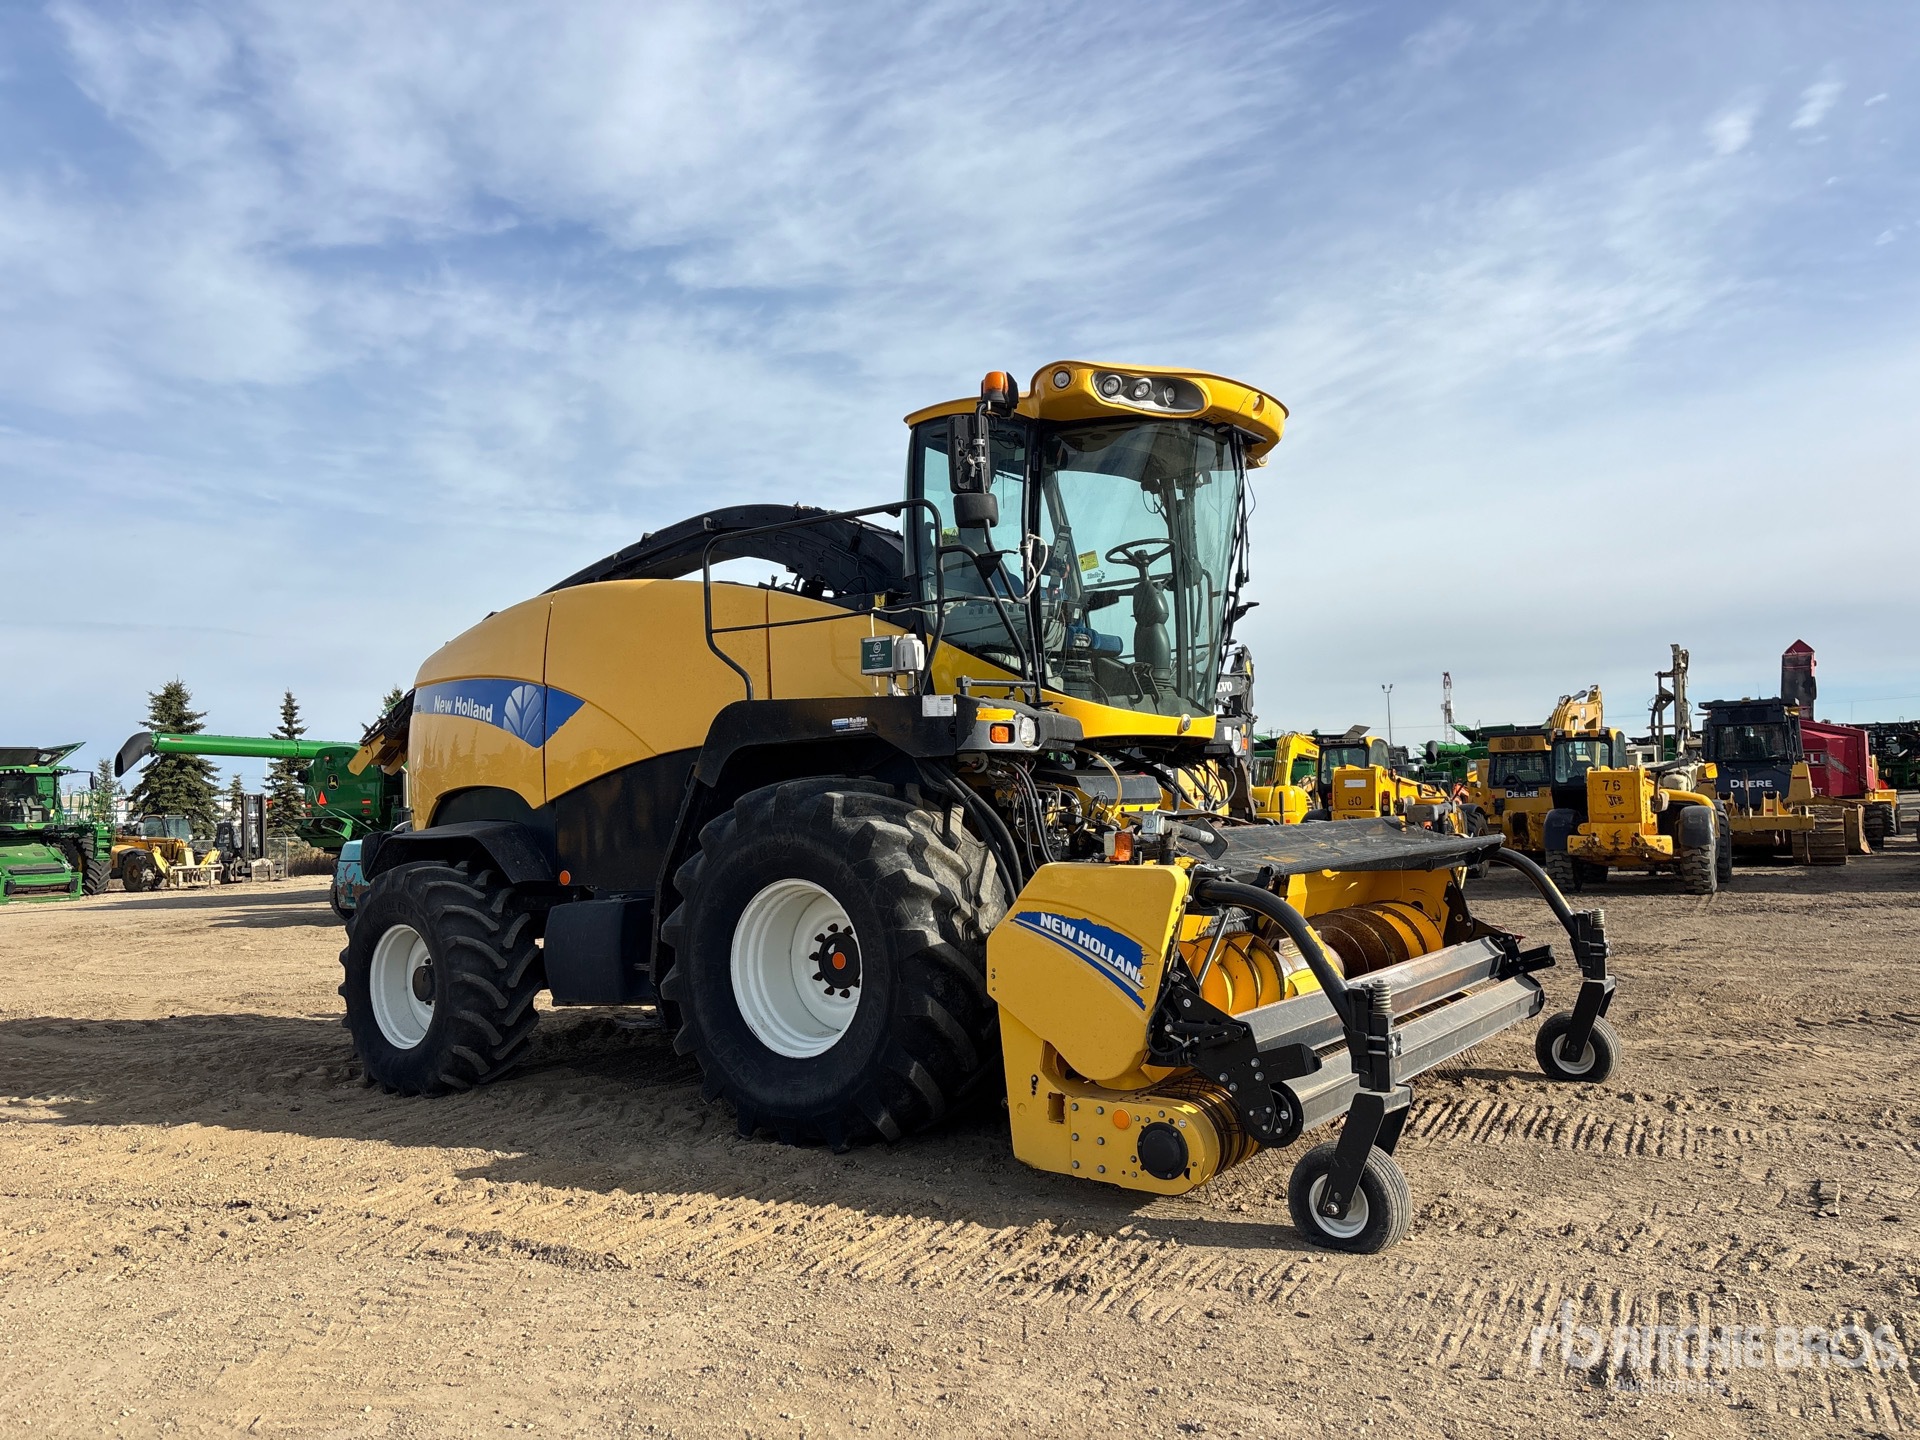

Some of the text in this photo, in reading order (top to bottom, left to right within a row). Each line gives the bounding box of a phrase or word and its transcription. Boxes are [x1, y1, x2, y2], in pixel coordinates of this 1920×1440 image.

[433, 694, 494, 723] New Holland
[1602, 779, 1621, 791] 76
[1729, 779, 1774, 788] DEERE
[1505, 789, 1539, 799] DEERE
[1040, 912, 1077, 940] NEW
